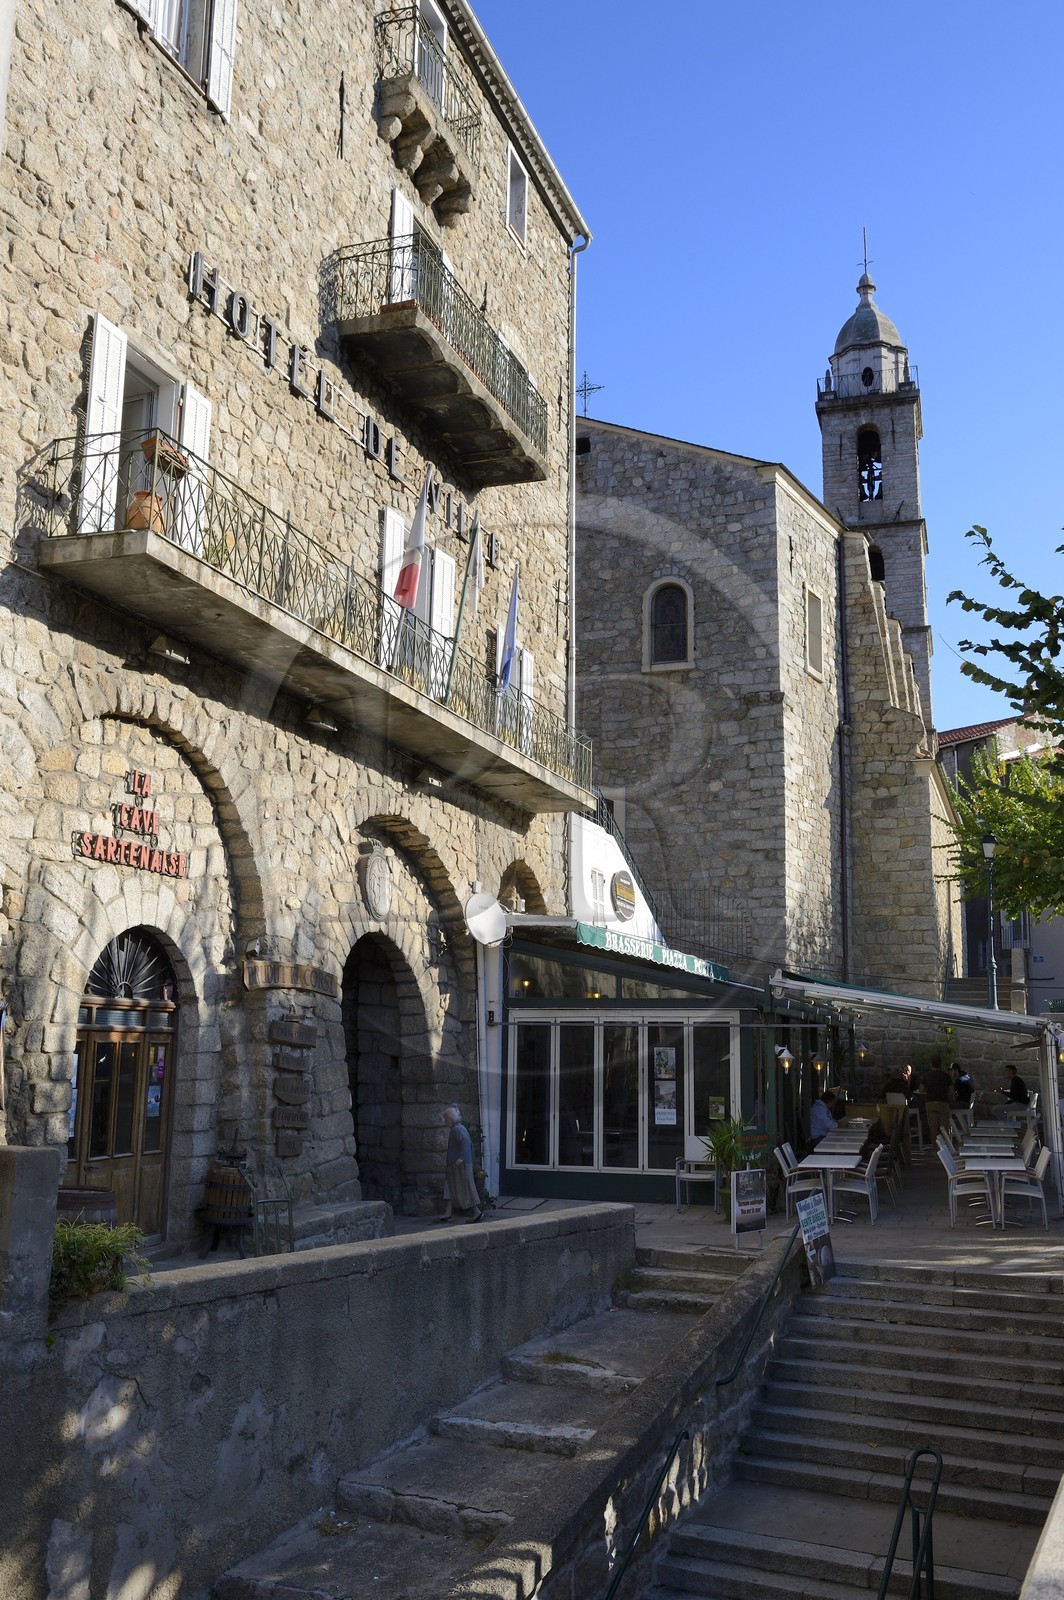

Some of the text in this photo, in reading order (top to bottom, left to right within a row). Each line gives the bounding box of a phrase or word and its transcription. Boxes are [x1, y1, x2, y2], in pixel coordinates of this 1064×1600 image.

[190, 251, 500, 570] HOTEL DE VILE
[133, 769, 151, 796] LA
[120, 802, 161, 835] CAVE
[81, 831, 188, 877] SARTENAISE
[605, 931, 715, 979] BRASSERIE PIAZZA PORTA
